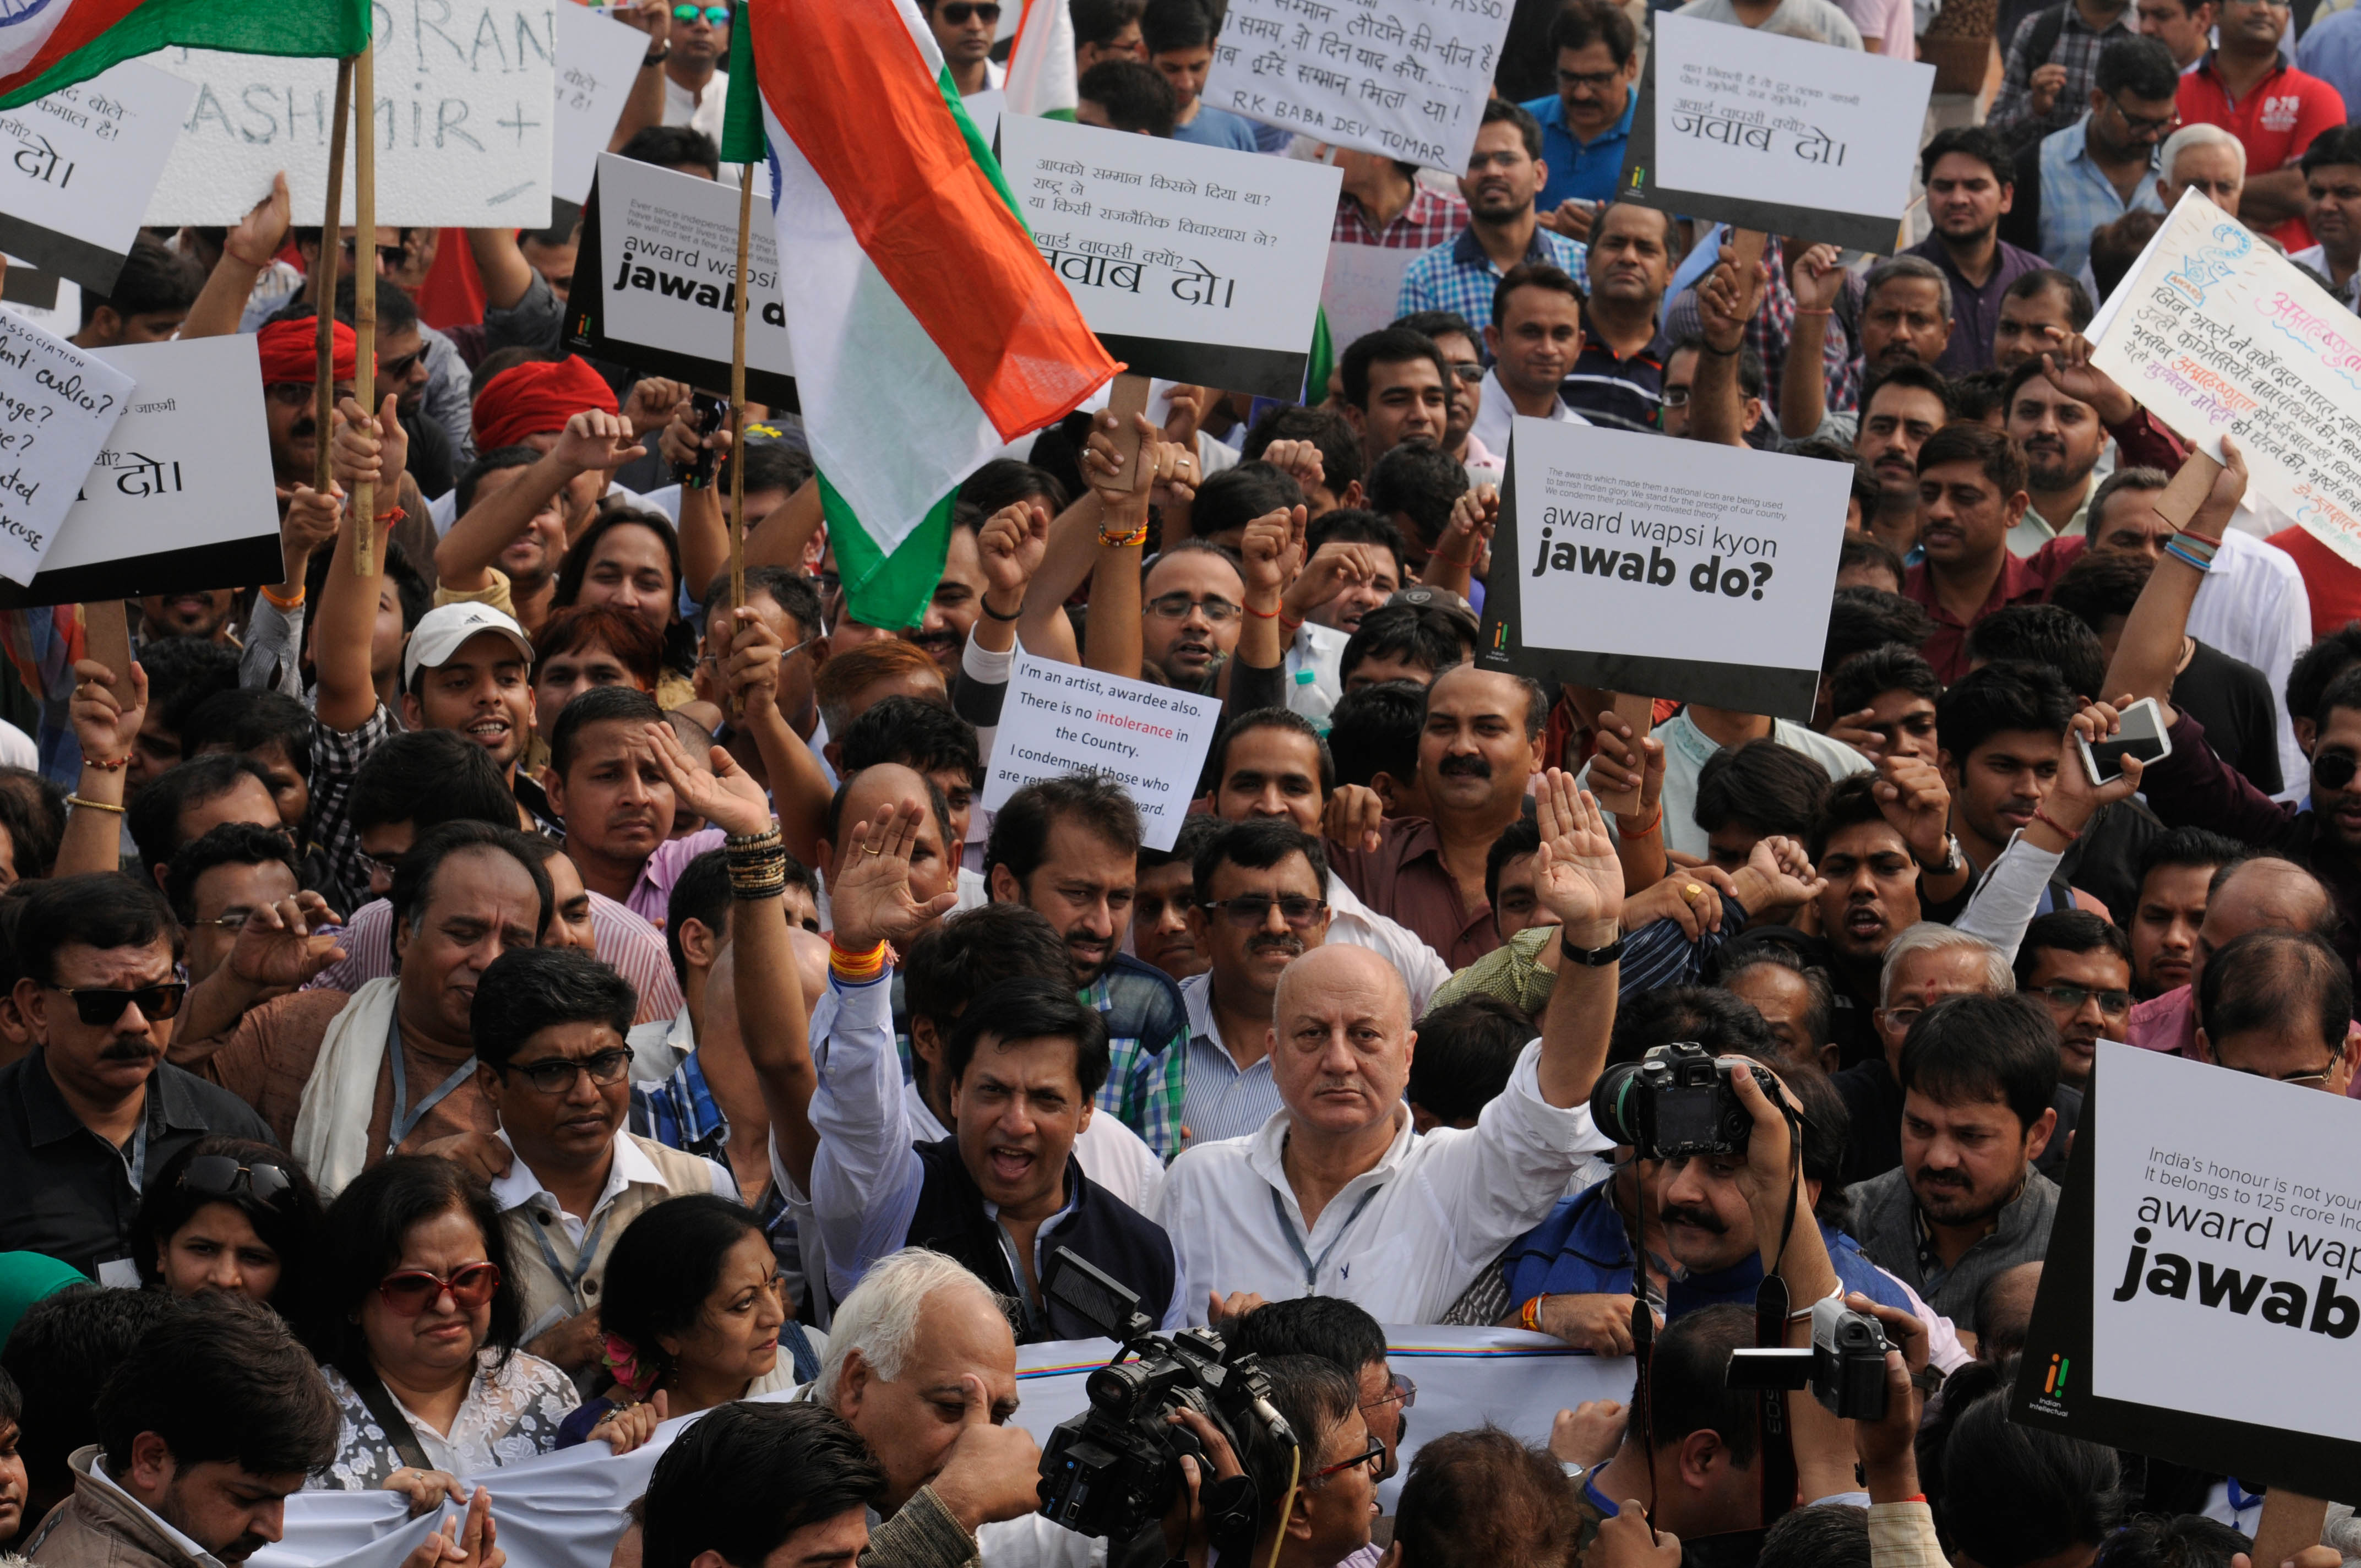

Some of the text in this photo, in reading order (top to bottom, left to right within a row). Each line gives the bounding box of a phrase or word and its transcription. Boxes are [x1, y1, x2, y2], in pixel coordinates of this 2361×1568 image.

[1233, 91, 1449, 168] RK BABA DEV TOMAR
[1671, 108, 1776, 153] जवाब
[1033, 178, 1084, 195] राष्ट्र ने
[1036, 159, 1270, 205] आपको सम्मान किसने दिया था?
[1029, 197, 1277, 246] या किसी राजनैतिक विचारधारा ने?
[625, 236, 699, 267] award
[0, 316, 84, 368] ASSOCIATION
[1546, 487, 1720, 521] We condemn their politically motivated theory.
[1549, 467, 1563, 476] The
[1565, 471, 1592, 481] awards
[1594, 476, 1616, 484] which
[1618, 480, 1640, 488] made
[1642, 482, 1661, 491] them
[1671, 487, 1701, 497] national
[1703, 491, 1720, 499] icon
[1737, 496, 1760, 508] being
[1762, 501, 1782, 509] used
[1556, 479, 1581, 488] tarnish
[1584, 483, 1606, 492] Indian
[1608, 487, 1628, 497] glory.
[1631, 489, 1644, 498] We
[1646, 493, 1667, 502] stand
[1669, 495, 1679, 503] for
[1682, 497, 1694, 506] the
[1696, 501, 1728, 511] prestige
[1756, 510, 1787, 521] country.
[1544, 507, 1777, 557] award wapsi kyon
[1532, 527, 1774, 601] jawab do?
[1045, 672, 1061, 683] an
[1065, 677, 1103, 695] artist,
[1108, 687, 1167, 709] awardee
[1171, 700, 1200, 716] also.
[1021, 692, 1188, 742] There is no intolerance in
[1056, 727, 1138, 758] the Country.
[998, 770, 1020, 783] are
[1018, 749, 1098, 776] condemned
[1097, 766, 1138, 785] those
[1143, 777, 1169, 791] who
[2145, 1166, 2335, 1224] It belongs to 125 crore
[2150, 1147, 2202, 1172] India's
[2208, 1161, 2270, 1188] honour
[2274, 1178, 2287, 1193] is
[2293, 1185, 2321, 1201] not
[2138, 1196, 2273, 1250] award
[2113, 1227, 2360, 1339] jawab
[2029, 1403, 2069, 1417] Intellectual
[2039, 1398, 2061, 1408] Indian
